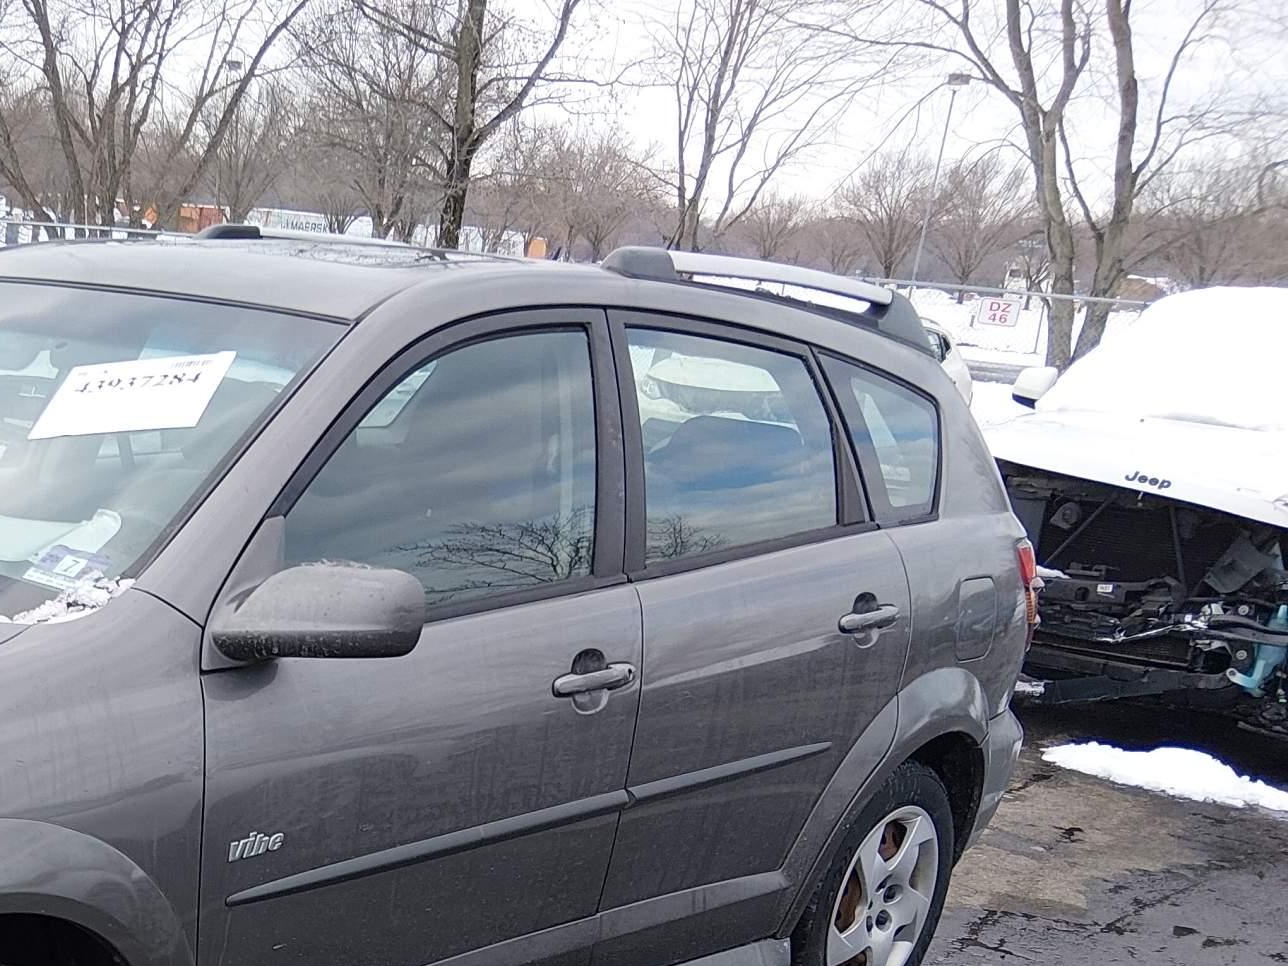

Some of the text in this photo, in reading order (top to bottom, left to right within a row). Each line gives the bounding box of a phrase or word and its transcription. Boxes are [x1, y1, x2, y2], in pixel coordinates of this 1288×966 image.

[291, 220, 328, 233] MAERSK
[989, 301, 1012, 313] DZ
[988, 313, 1009, 324] 46
[1124, 470, 1172, 490] Jeep
